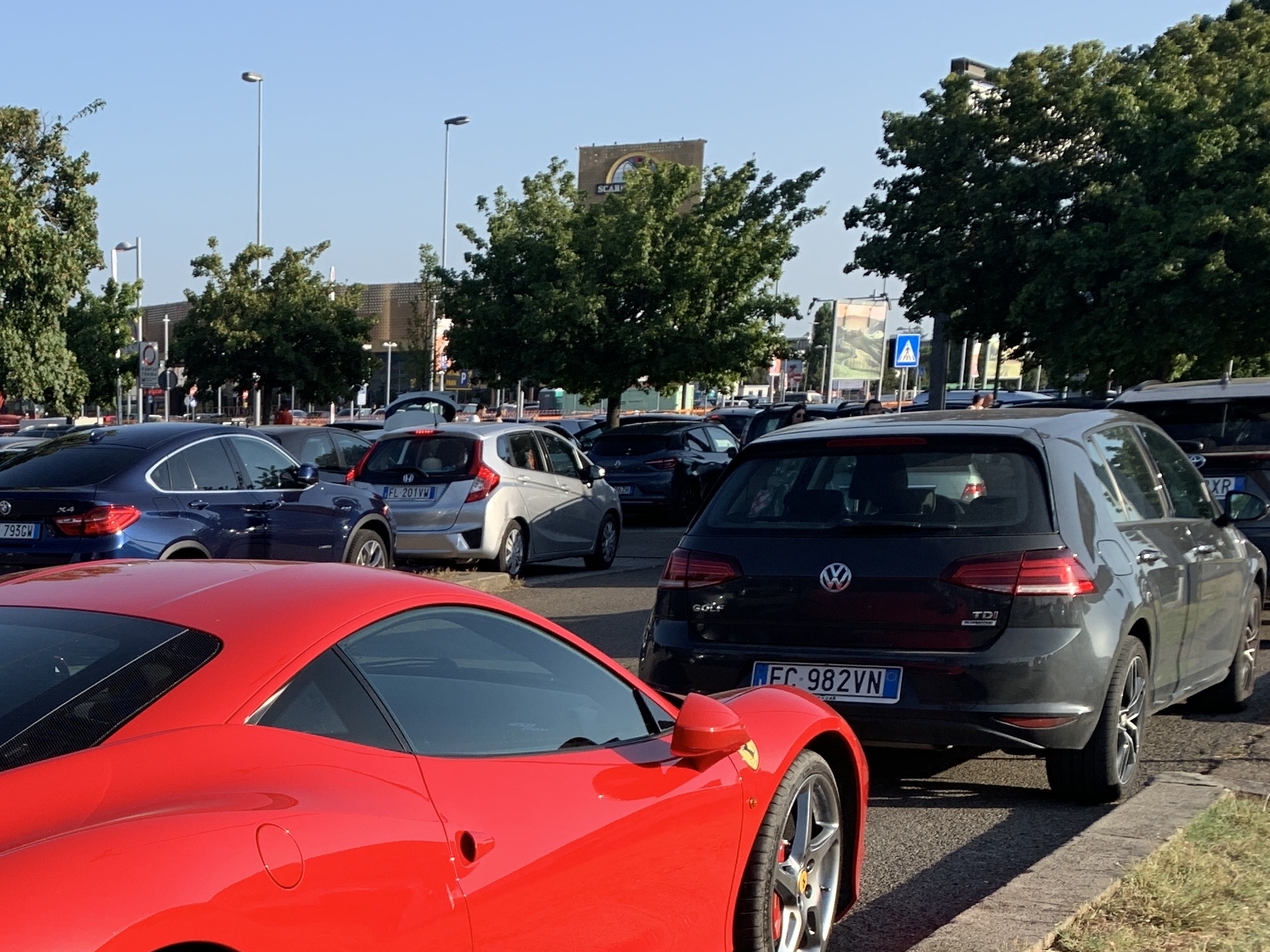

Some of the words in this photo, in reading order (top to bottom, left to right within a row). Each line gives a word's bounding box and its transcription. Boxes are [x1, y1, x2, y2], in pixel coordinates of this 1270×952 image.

[456, 371, 468, 385] P
[1206, 479, 1232, 495] XR
[3, 524, 34, 537] 793GW
[692, 603, 725, 613] GOLF
[972, 610, 999, 620] TDI
[807, 668, 883, 695] 982VN
